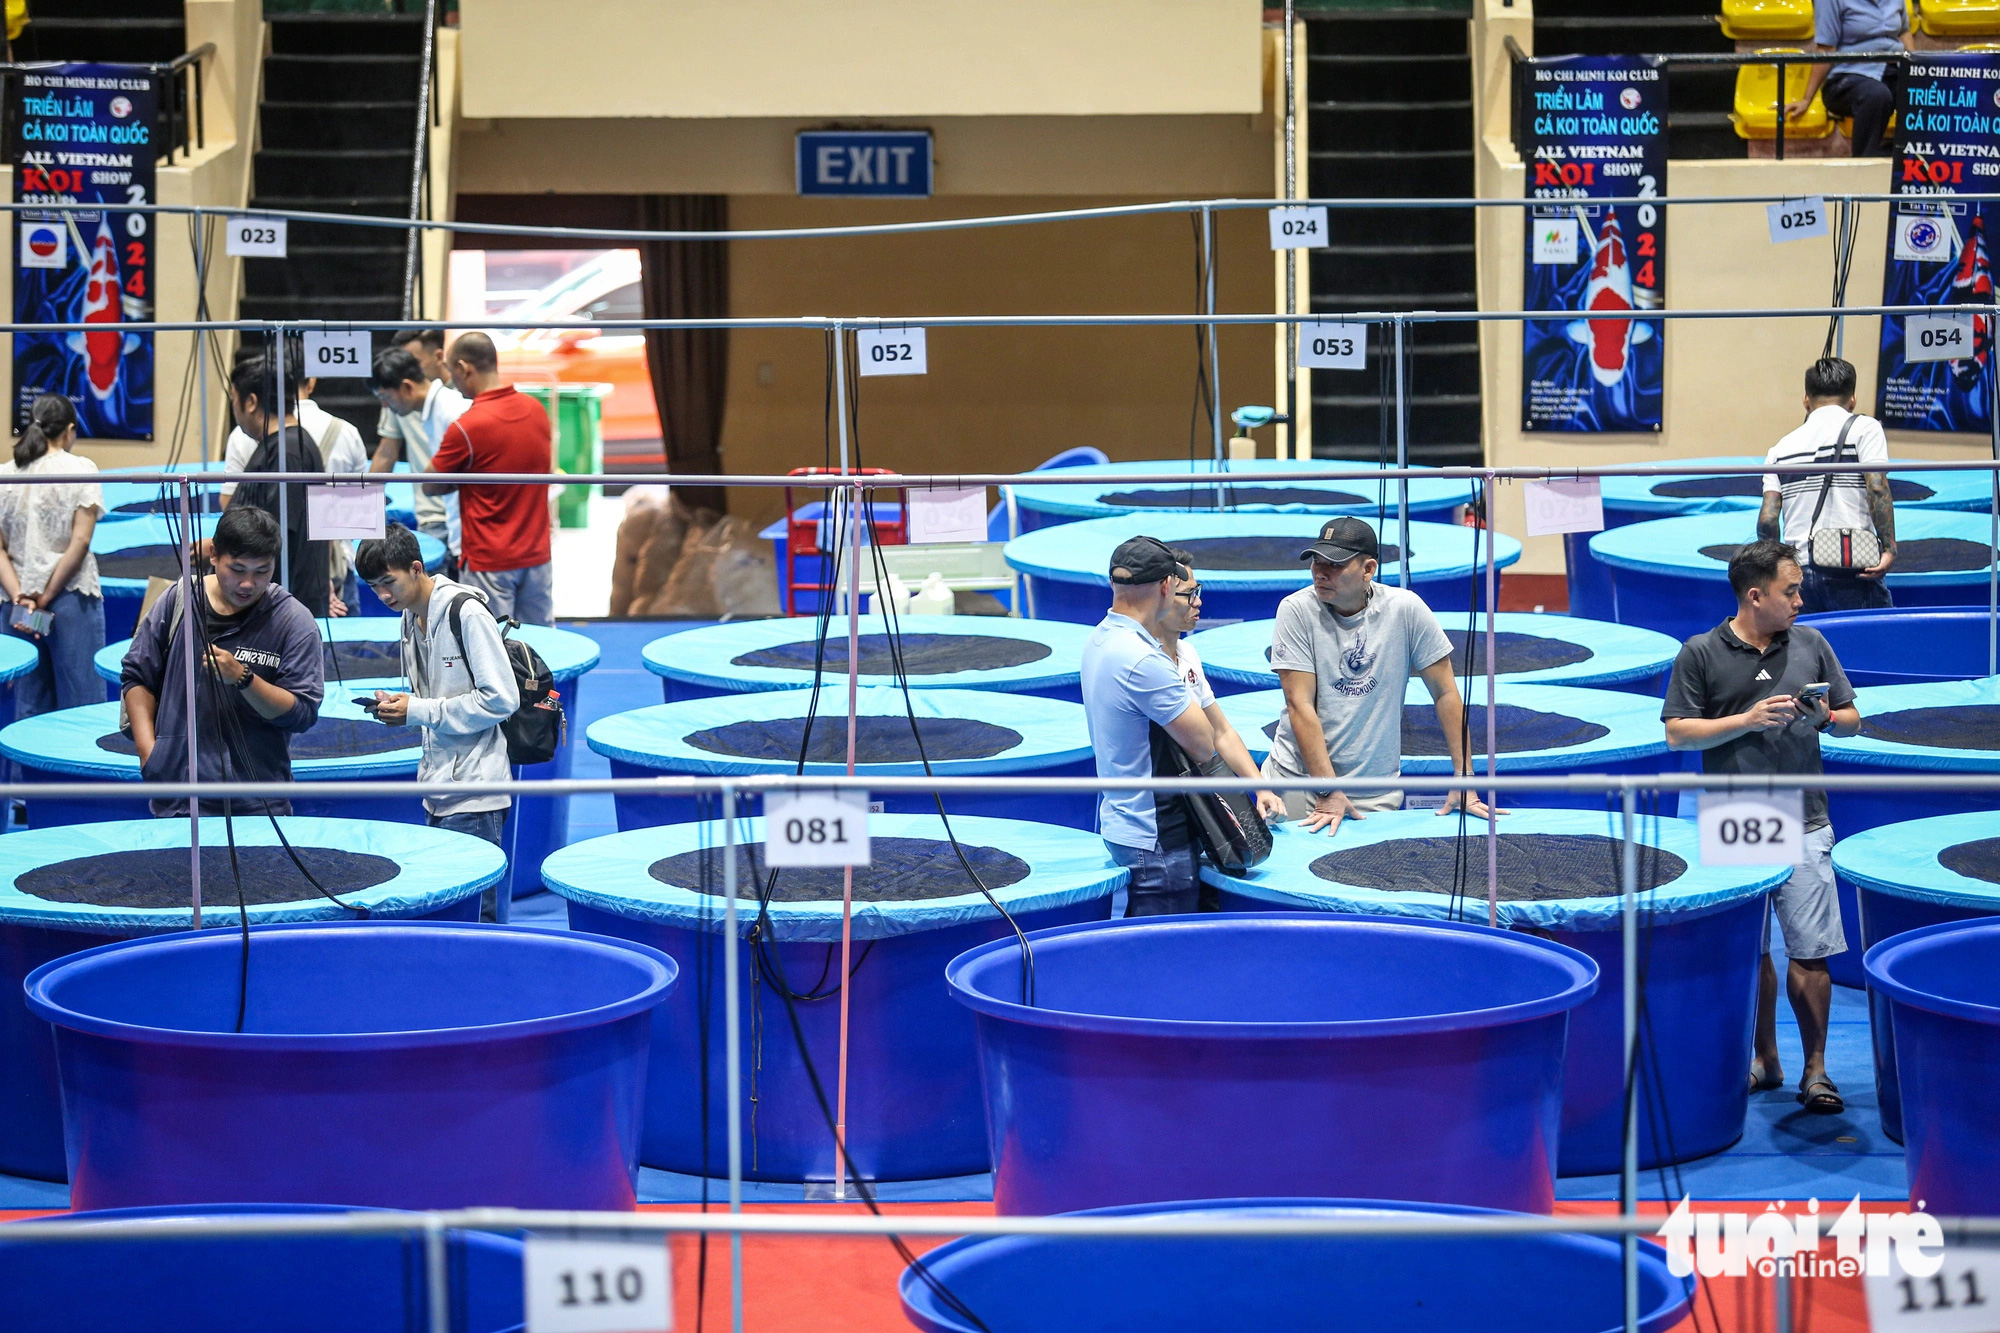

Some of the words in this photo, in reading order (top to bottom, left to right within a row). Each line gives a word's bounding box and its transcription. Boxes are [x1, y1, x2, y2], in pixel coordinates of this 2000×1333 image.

[1535, 69, 1552, 81] HO
[1554, 69, 1574, 81] CHI
[1575, 70, 1605, 81] MINH
[1607, 69, 1627, 81] KOI
[1629, 69, 1659, 81] CLUB
[1909, 65, 1926, 76] HO
[1928, 66, 1948, 77] CHI
[1950, 67, 1981, 79] MINH
[24, 75, 42, 87] HO
[43, 76, 64, 88] CHI
[65, 77, 96, 89] MINH
[97, 78, 118, 89] KOI
[119, 79, 150, 91] CLUB
[23, 89, 63, 116] TRIỂN
[1534, 84, 1573, 110] TRIỂN
[1575, 88, 1604, 110] LÃM
[1907, 80, 1945, 107] TRIỂN
[1949, 85, 1977, 108] LÃM
[22, 118, 43, 140] CÁ
[45, 123, 69, 142] KOI
[72, 121, 107, 143] TOÀN
[110, 120, 149, 144] QUỐC
[1534, 112, 1555, 136] CÁ
[1556, 117, 1579, 136] KOI
[1583, 113, 1618, 136] TOÀN
[1620, 110, 1659, 136] QUỐC
[1905, 108, 1925, 131] CÁ
[1927, 113, 1950, 132] KOI
[1954, 111, 1990, 134] TOÀN
[21, 151, 55, 165] ALL
[57, 152, 133, 167] VIETNAM
[1534, 145, 1566, 159] ALL
[1568, 145, 1644, 159] VIETNAM
[1903, 141, 1935, 155] ALL
[1938, 143, 2000, 158] VIETNA
[817, 146, 915, 184] EXIT
[1534, 162, 1596, 186] KOI
[1603, 163, 1644, 177] SHOW
[1902, 159, 1964, 183] KOI
[1972, 162, 2000, 176] SHO
[22, 168, 84, 192] KOI
[90, 171, 132, 185] SHOW
[1282, 219, 1318, 235] 024
[1781, 210, 1817, 229] 025
[241, 228, 276, 243] 023
[1312, 338, 1354, 356] 053
[1920, 328, 1962, 347] 054
[318, 346, 359, 364] 051
[871, 343, 912, 362] 052
[1334, 678, 1376, 696] CAMPAGNOLO
[786, 818, 848, 844] 081
[1720, 818, 1784, 844] 082
[559, 1267, 644, 1306] 110
[1897, 1268, 1988, 1312] 111
